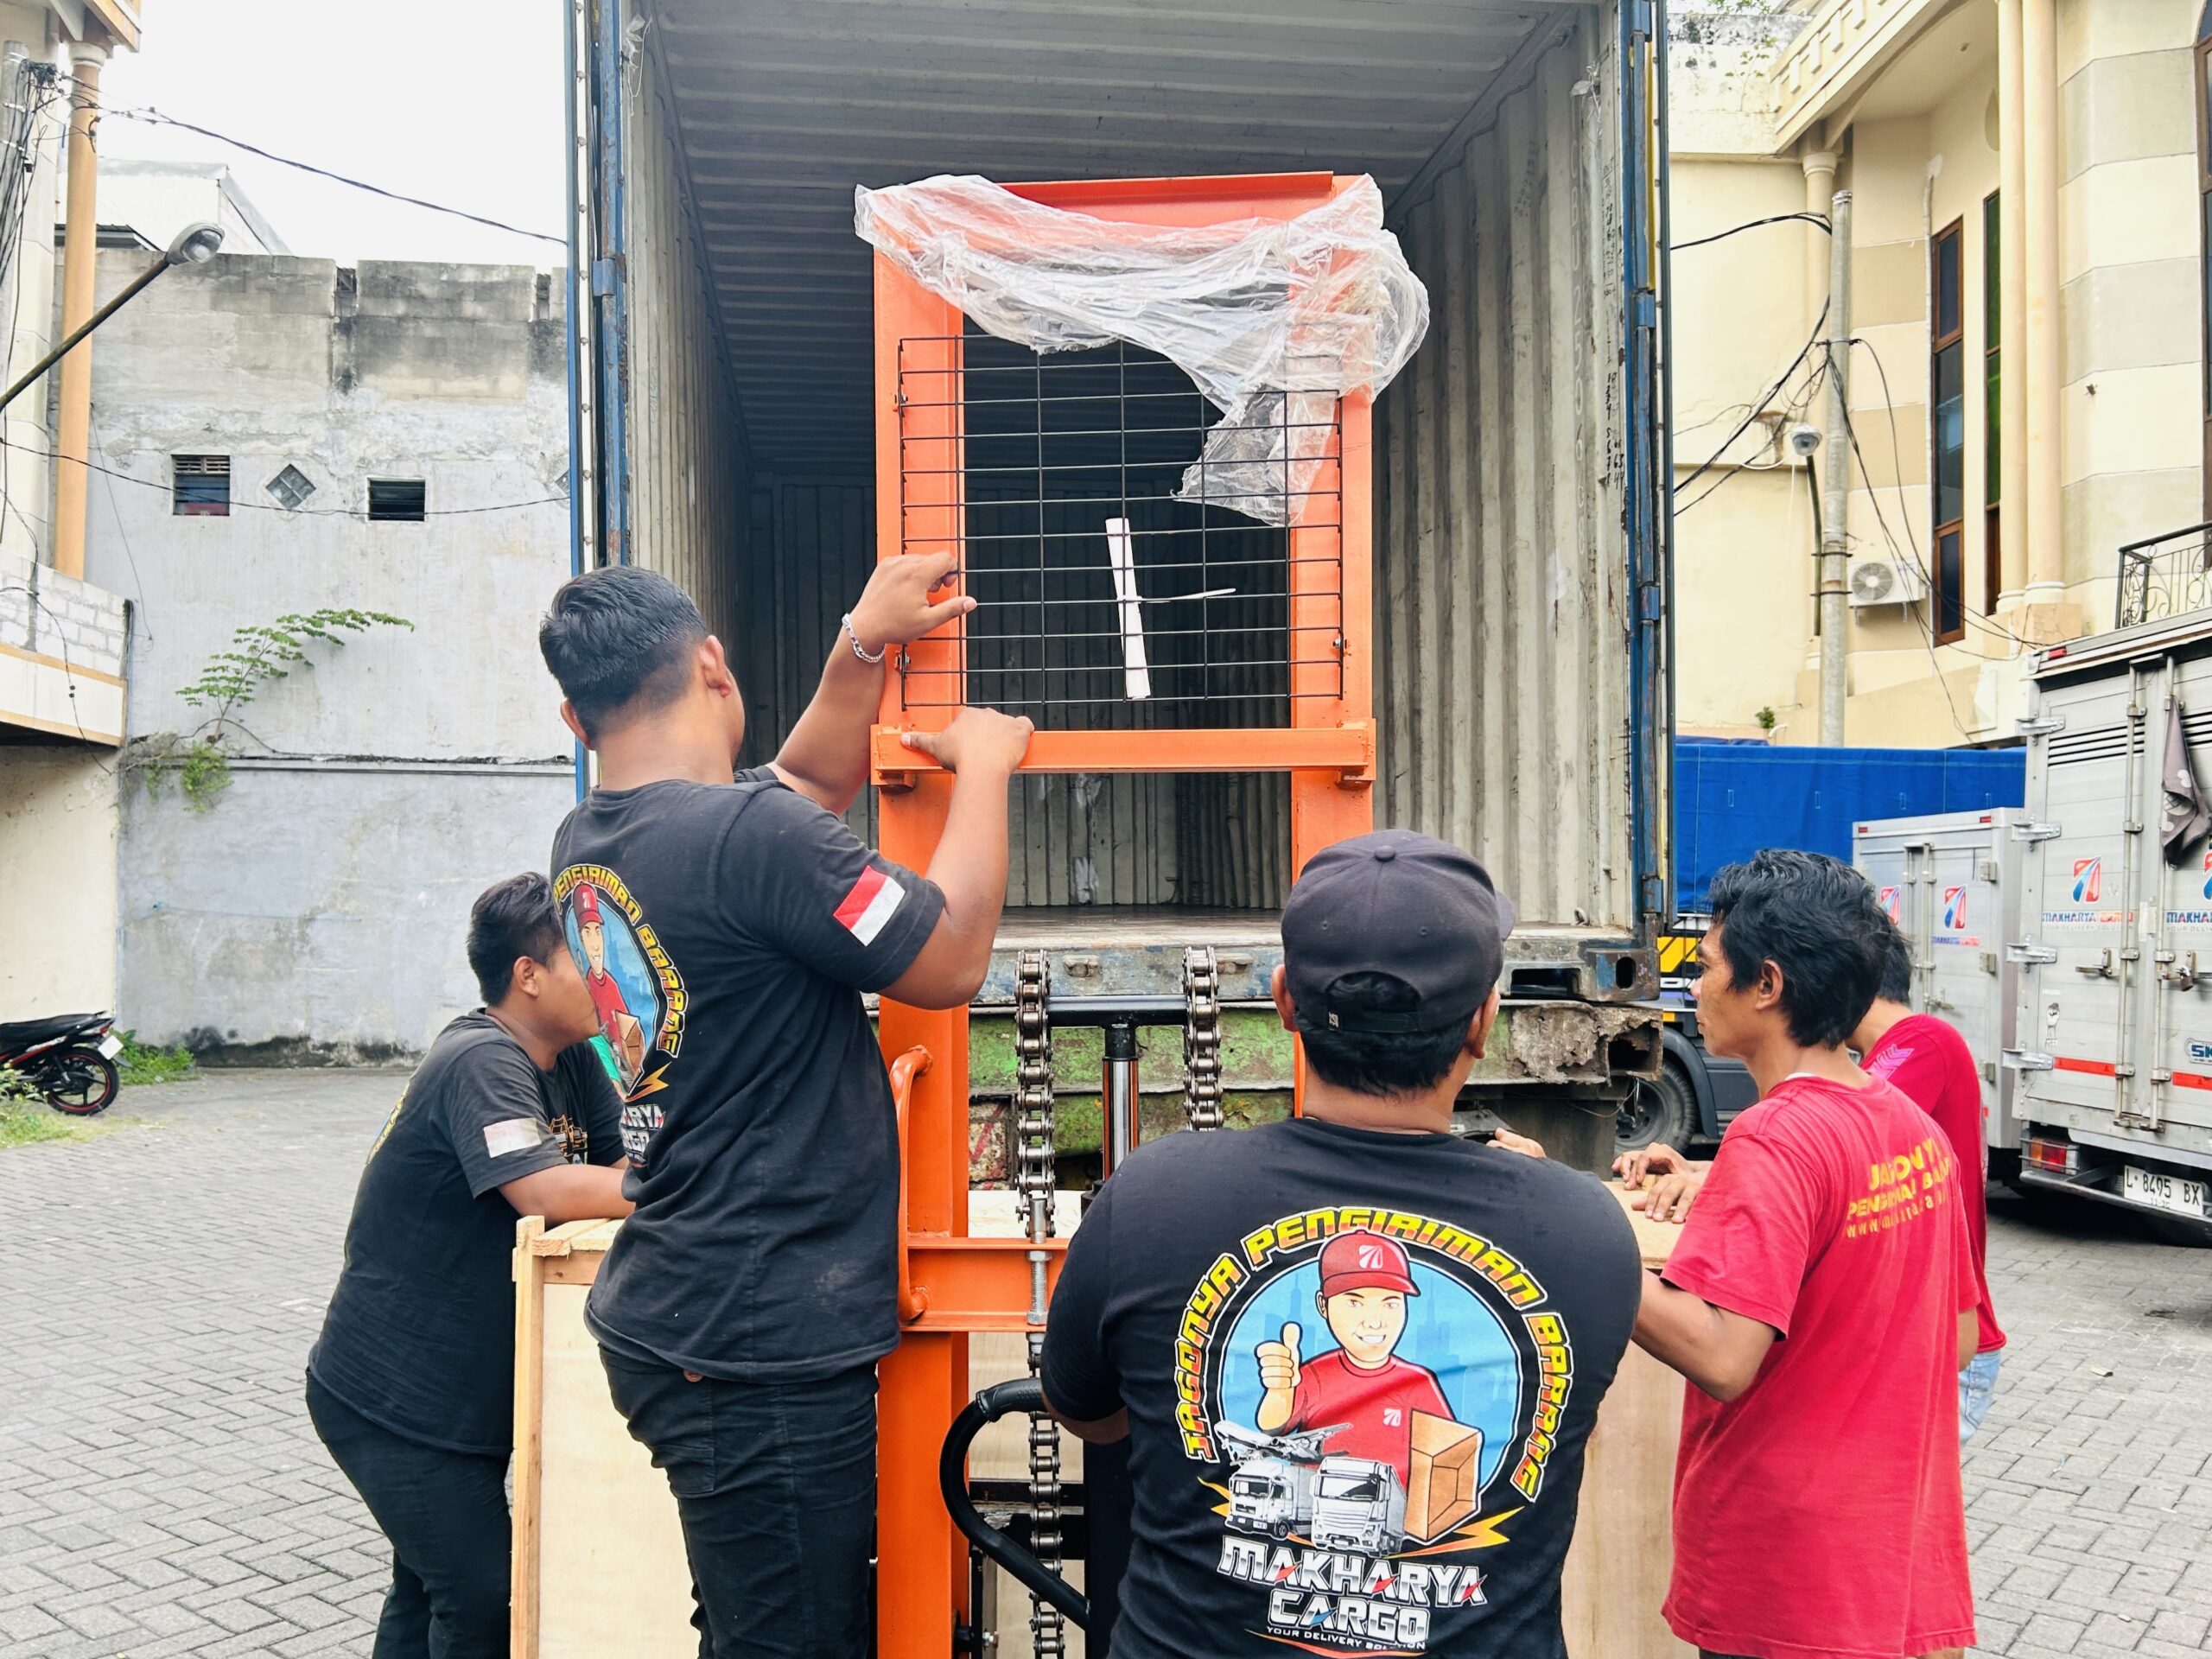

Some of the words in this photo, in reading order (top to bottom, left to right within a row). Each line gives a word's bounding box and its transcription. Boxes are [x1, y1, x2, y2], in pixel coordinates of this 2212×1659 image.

[2165, 912, 2212, 923] MAKHA
[635, 924, 689, 1058] BARANG
[2126, 1168, 2133, 1188] L
[2143, 1173, 2171, 1198] 8495
[2183, 1183, 2200, 1206] BX
[1177, 1254, 1249, 1460] JAGONYA
[1243, 1208, 1545, 1307] PENGIRIMAN
[1511, 1313, 1572, 1501] BARANG
[1217, 1536, 1486, 1606] MAKHARYA
[1266, 1626, 1299, 1637] YOUR
[1304, 1630, 1362, 1647] DELIVERY
[1268, 1589, 1429, 1643] CARGO
